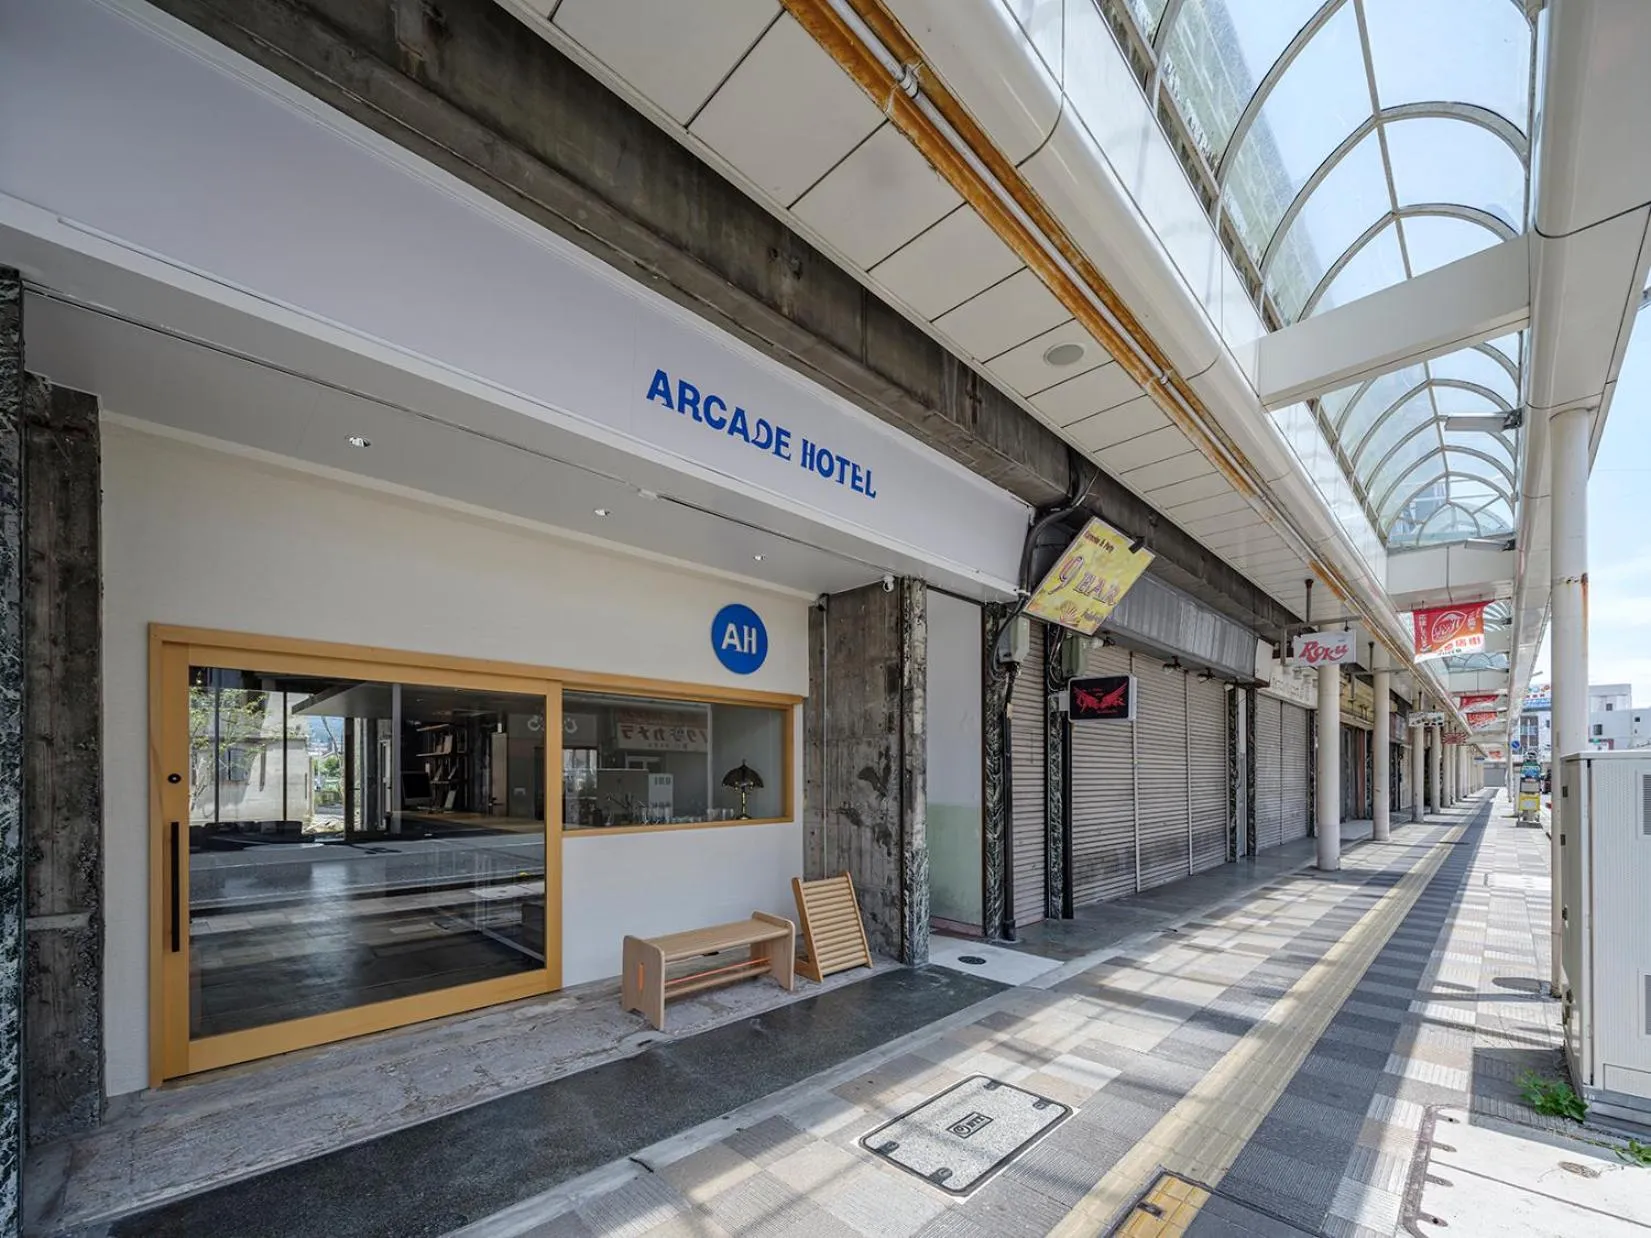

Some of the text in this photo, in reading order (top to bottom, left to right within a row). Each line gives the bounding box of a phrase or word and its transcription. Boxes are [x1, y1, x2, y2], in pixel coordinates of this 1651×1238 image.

[646, 369, 877, 498] ARCADE HOTEL
[1073, 571, 1118, 605] BAR
[721, 622, 757, 654] AH
